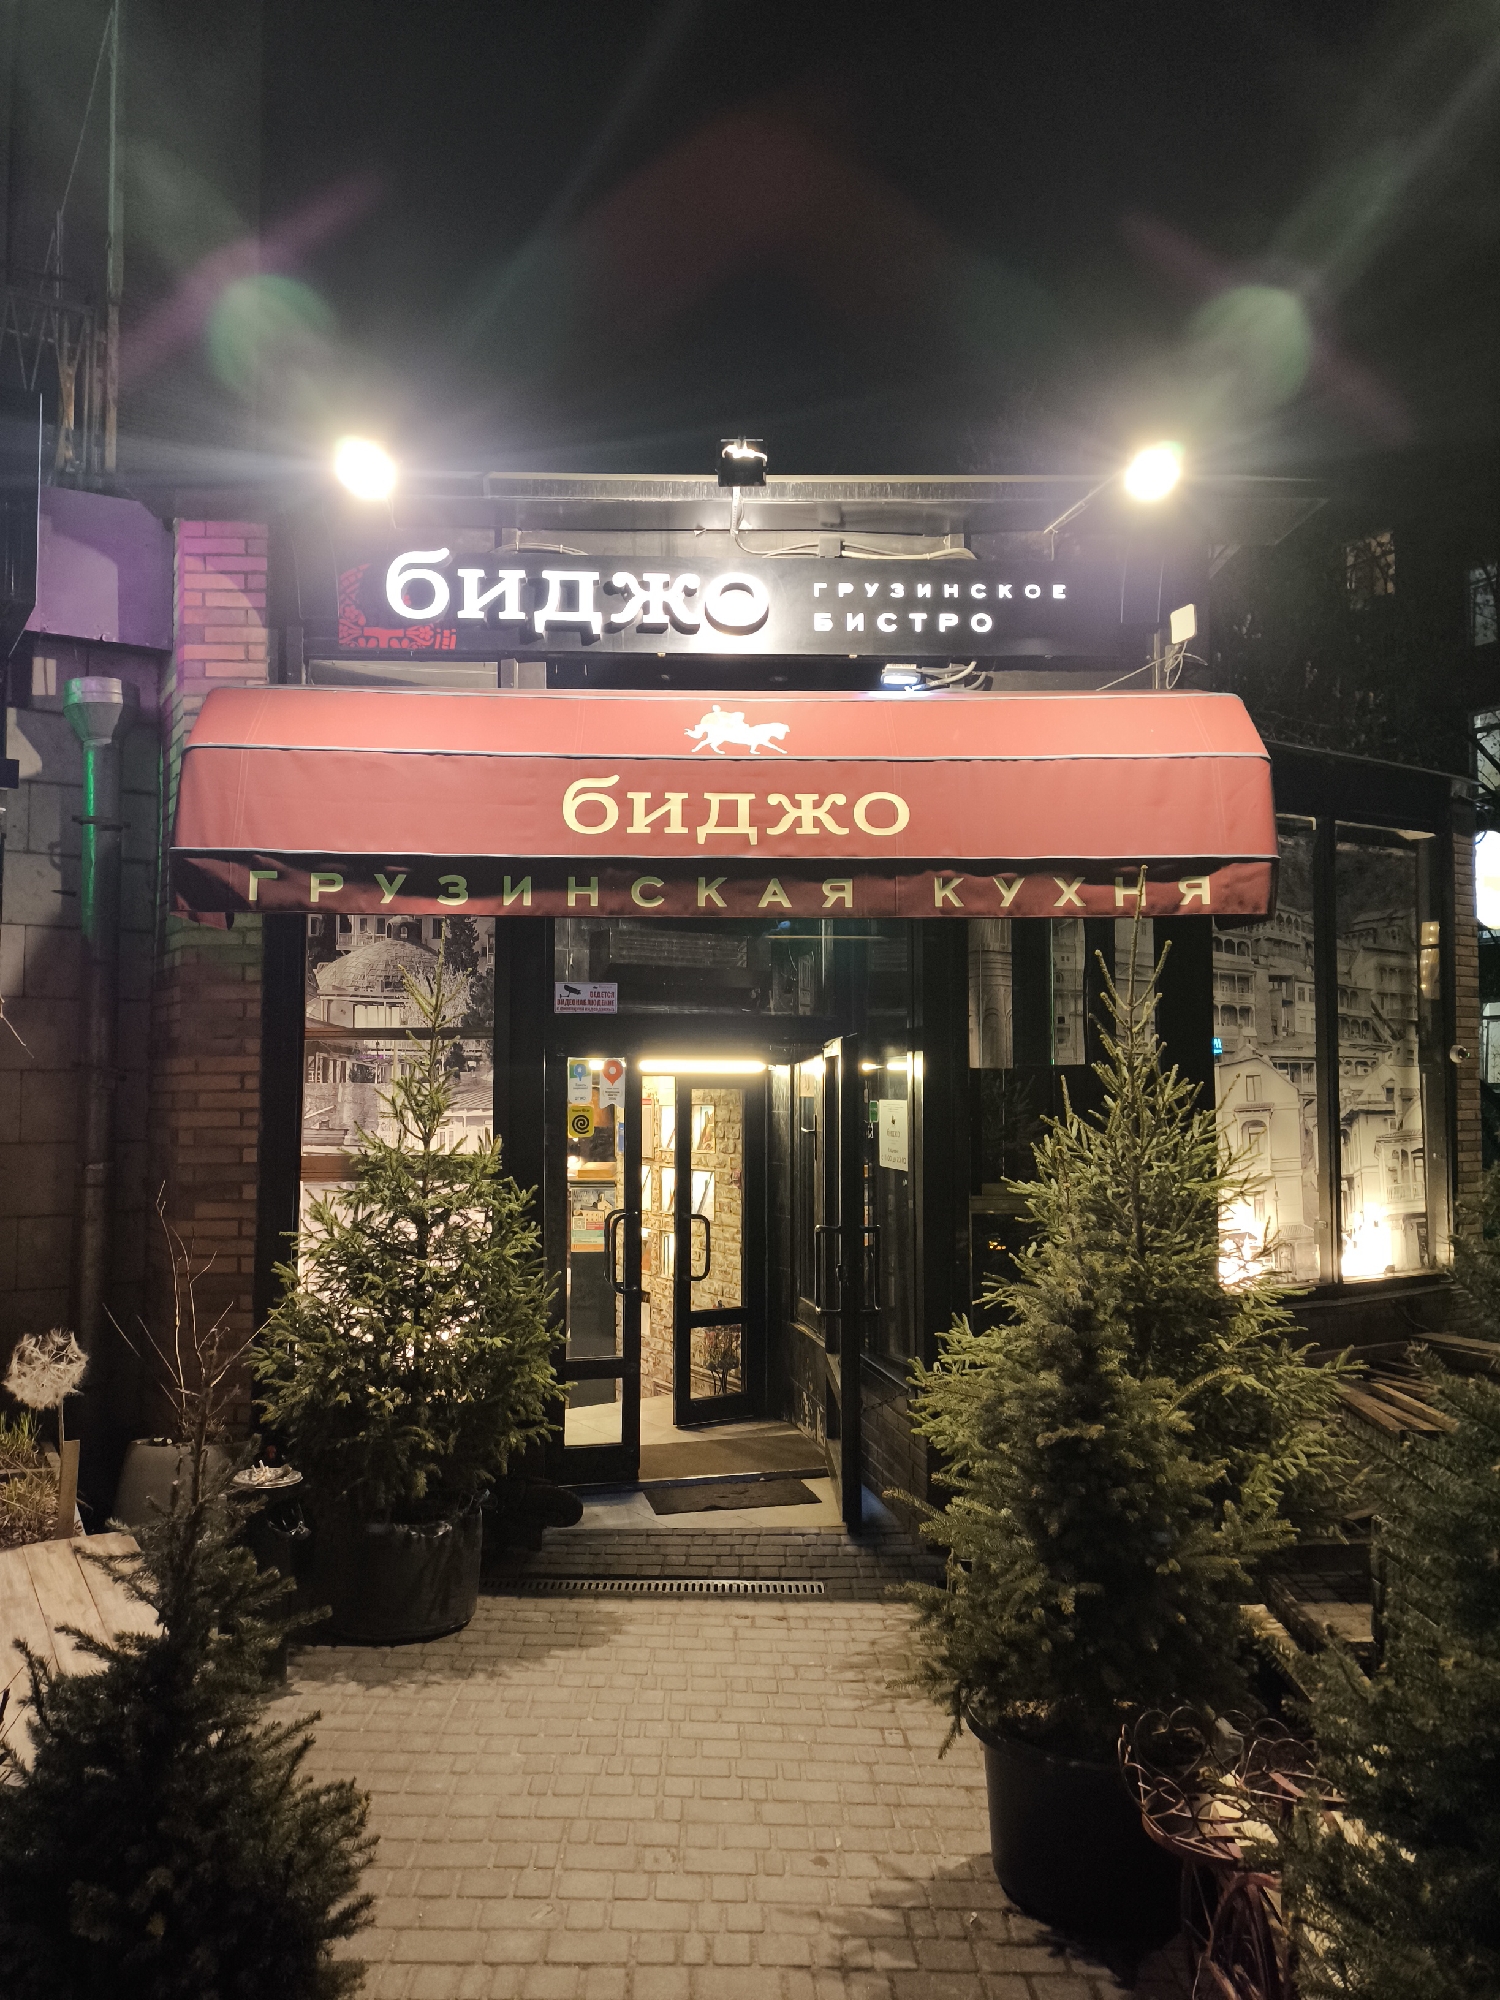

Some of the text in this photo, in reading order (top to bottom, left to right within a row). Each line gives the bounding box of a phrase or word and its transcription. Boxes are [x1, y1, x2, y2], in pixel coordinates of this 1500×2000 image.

[386, 547, 770, 636] биджо
[813, 582, 1067, 599] ГРУЗИНСКОЕ
[813, 612, 993, 633] БИСТРО
[562, 774, 911, 846] биджо
[248, 870, 1212, 909] ГРУЗИНСКАЯ КУХНЯ
